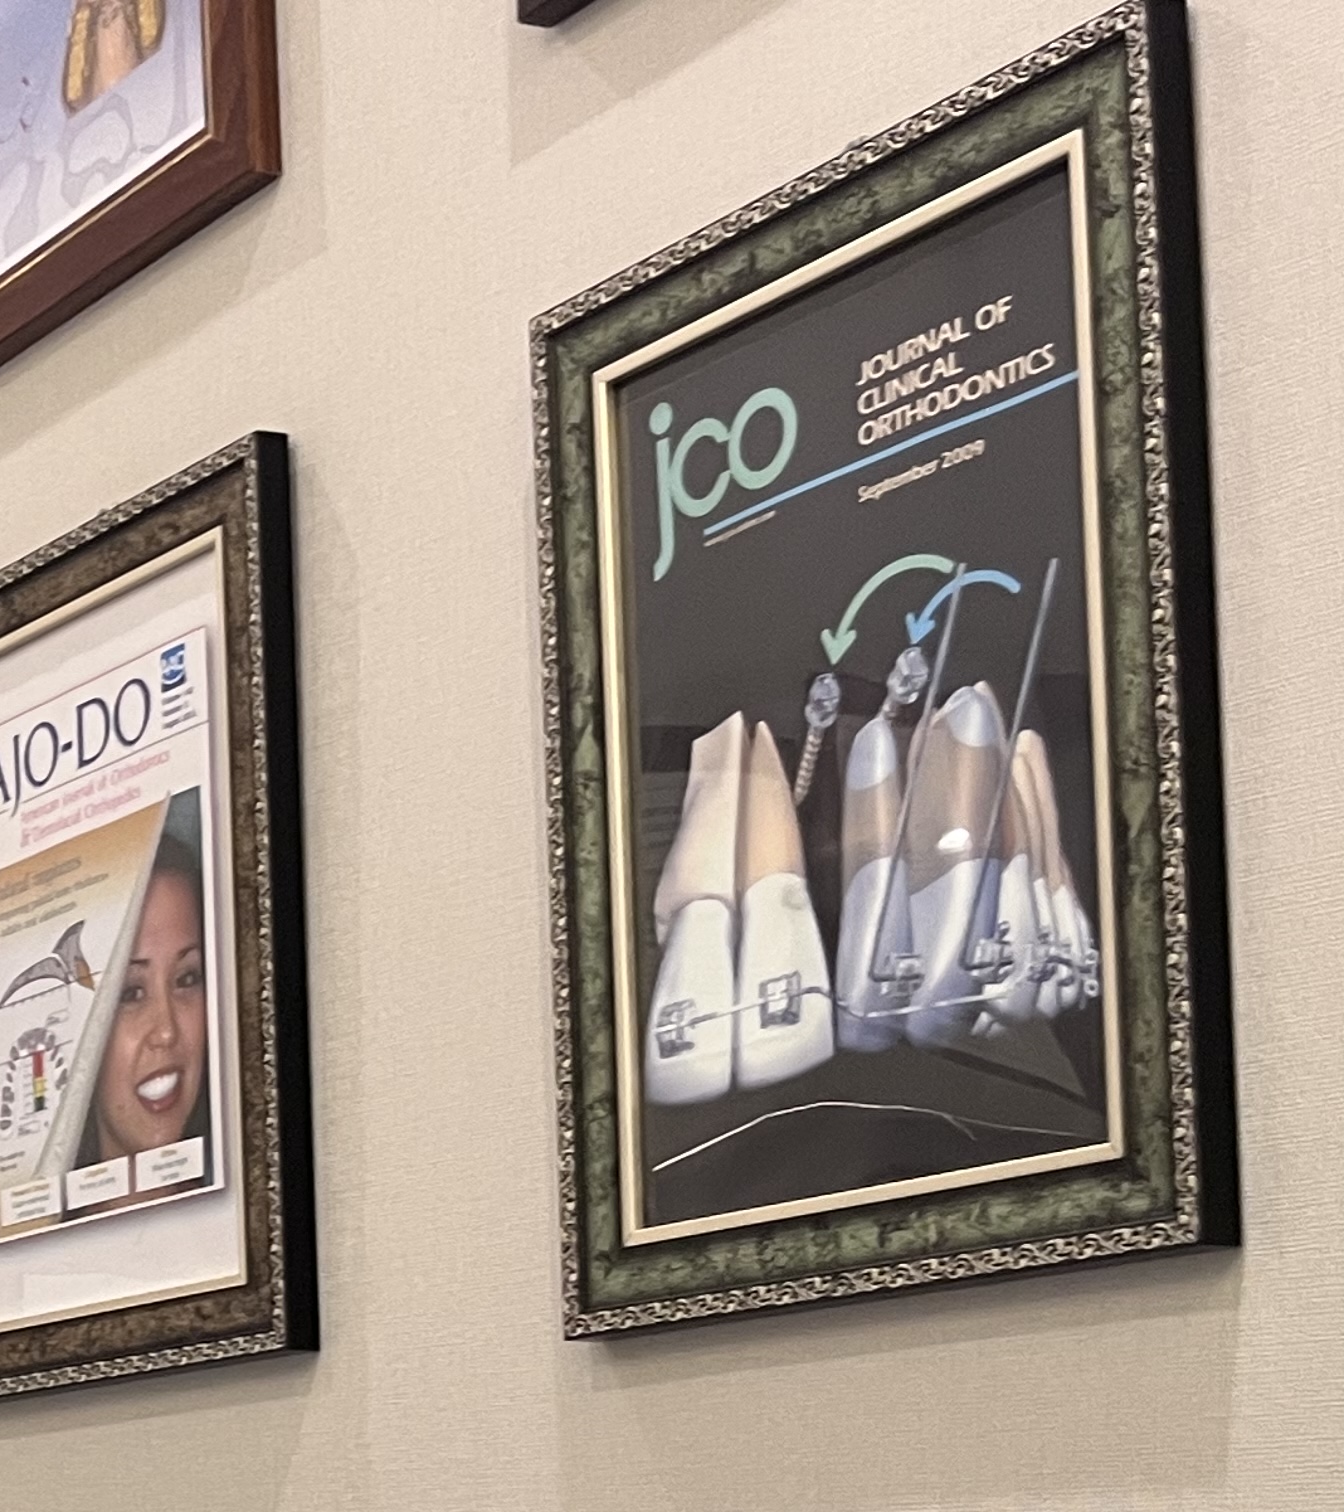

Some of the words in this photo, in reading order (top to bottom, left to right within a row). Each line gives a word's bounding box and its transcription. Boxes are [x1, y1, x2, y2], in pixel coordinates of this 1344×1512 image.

[855, 317, 970, 387] JOURNAL
[974, 295, 1014, 333] OF
[856, 352, 964, 415] CLINICAL
[856, 342, 1056, 446] ORTHODONTICS
[648, 387, 798, 582] jco
[857, 455, 939, 504] September
[940, 438, 986, 473] 2009
